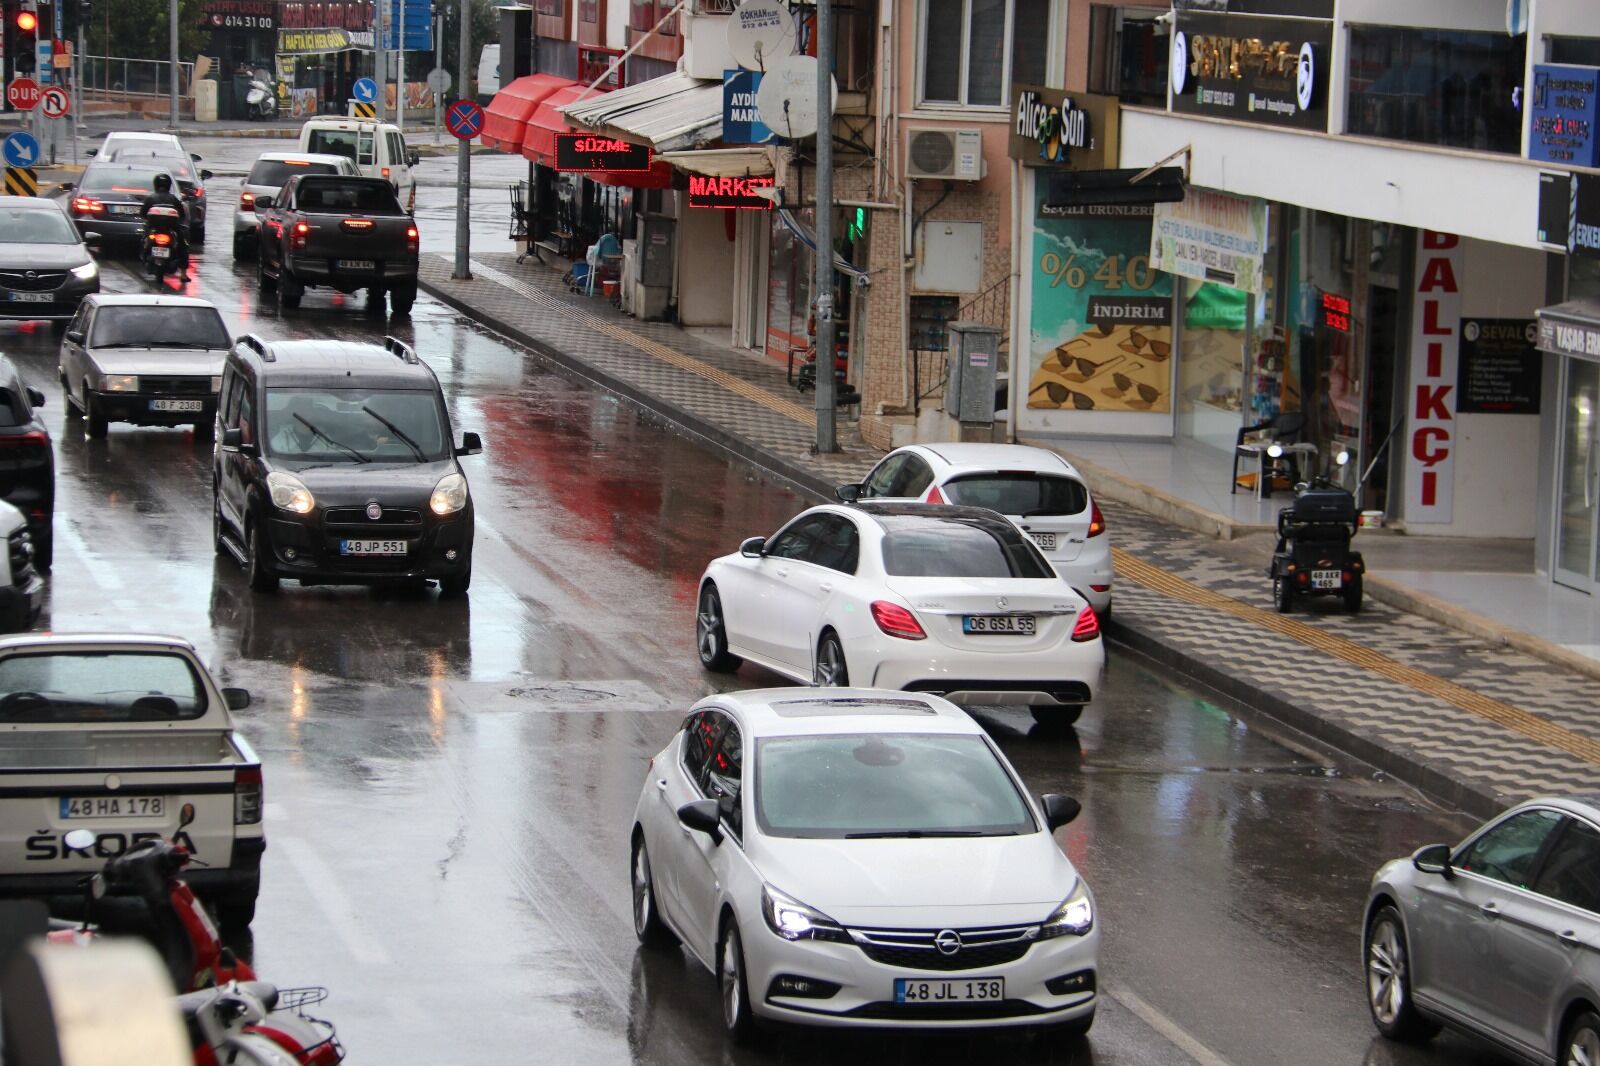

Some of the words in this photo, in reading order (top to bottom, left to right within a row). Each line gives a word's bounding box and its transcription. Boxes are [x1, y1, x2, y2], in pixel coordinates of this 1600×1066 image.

[225, 16, 243, 27] 614
[245, 16, 256, 27] 31
[259, 17, 272, 28] 00
[285, 34, 305, 49] HAFTA
[314, 32, 328, 48] HER
[328, 30, 347, 47] GÜN
[10, 87, 39, 100] DUR
[731, 91, 759, 106] AYDİ
[1016, 91, 1047, 139] Alice
[1060, 98, 1084, 147] Sun
[574, 138, 630, 152] SÜZME
[1093, 303, 1165, 319] İNDİRİM
[1481, 325, 1524, 339] SEVAL
[1412, 229, 1459, 506] BALIKÇI
[155, 401, 166, 409] 48
[347, 542, 362, 552] 48
[365, 542, 379, 552] JP
[383, 542, 405, 552] 551
[1313, 571, 1323, 579] 48
[1325, 571, 1339, 579] AKR
[970, 616, 985, 630] 06
[989, 617, 1014, 631] GSA
[1018, 618, 1034, 630] 55
[69, 800, 92, 815] 48
[97, 799, 120, 815] HA
[128, 798, 162, 814] 178
[905, 983, 930, 1000] 48
[935, 983, 958, 1000] JL
[966, 982, 1000, 999] 138
